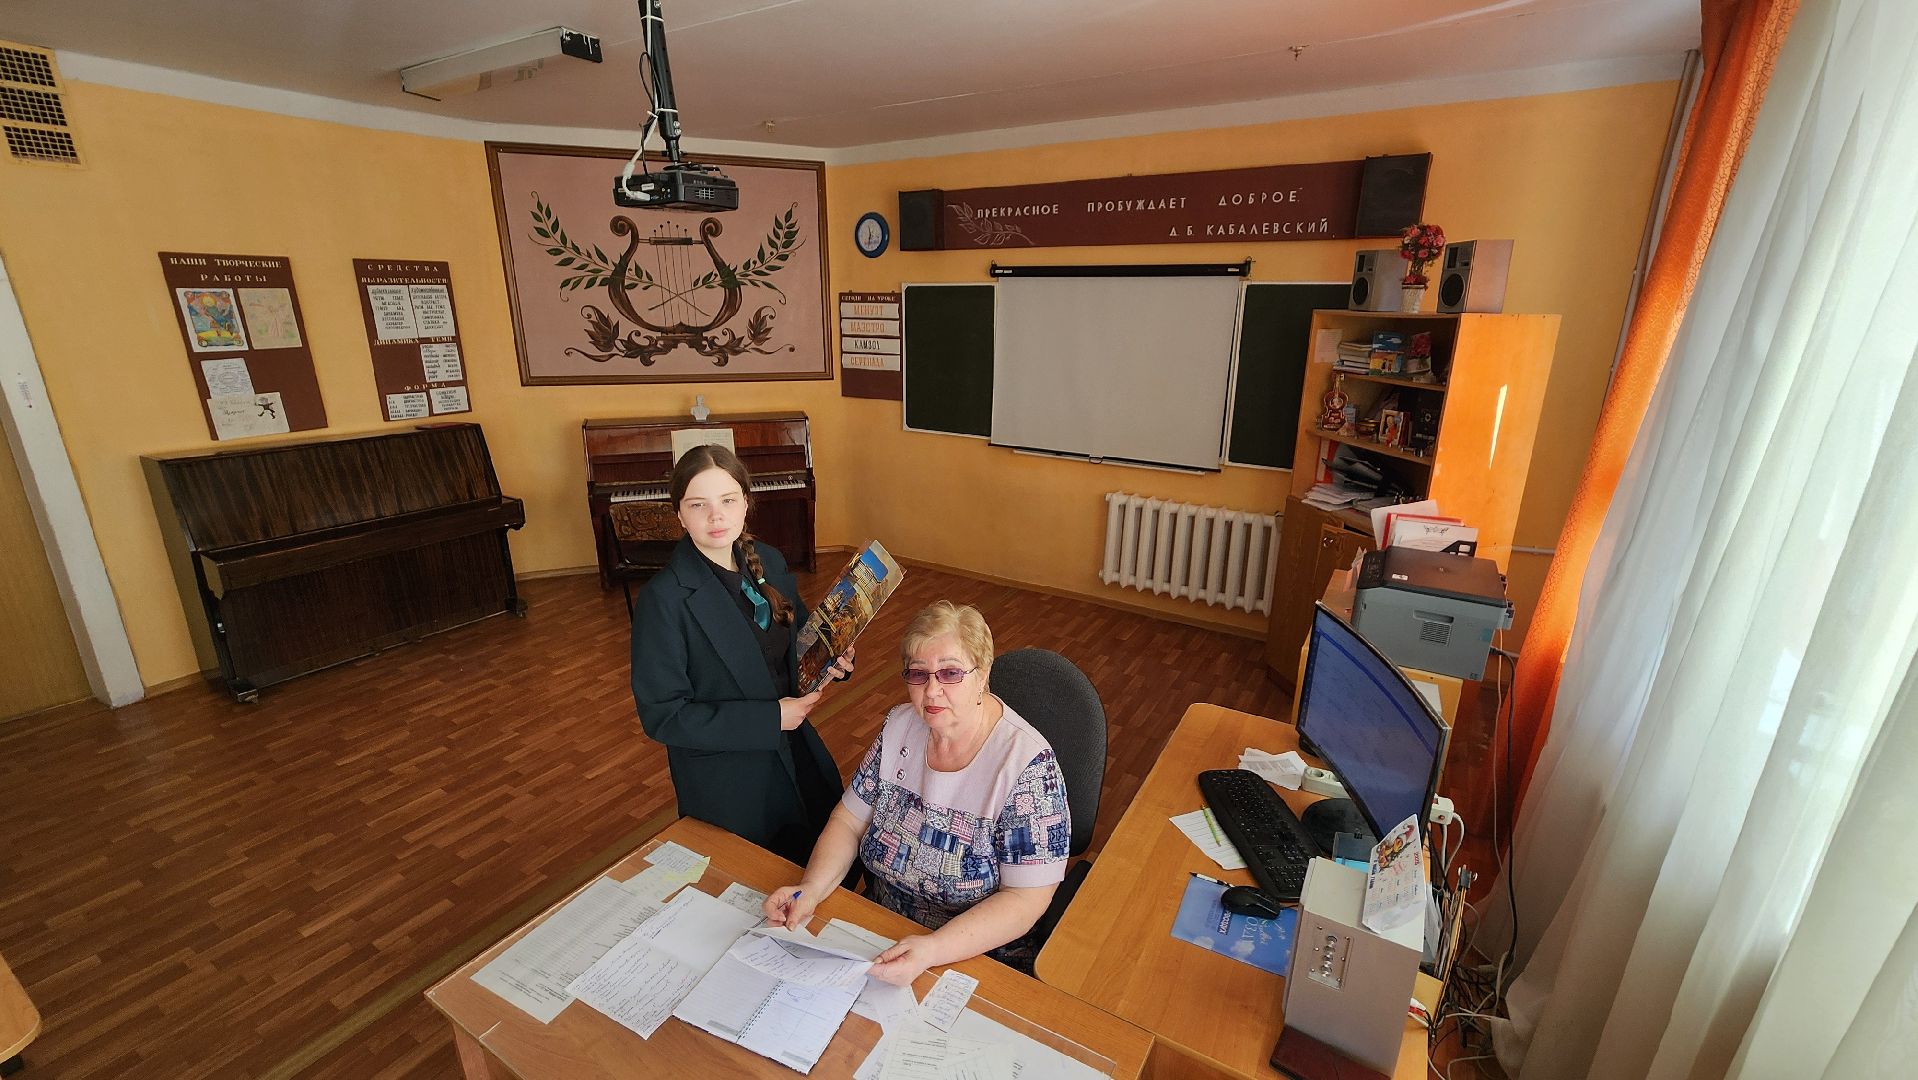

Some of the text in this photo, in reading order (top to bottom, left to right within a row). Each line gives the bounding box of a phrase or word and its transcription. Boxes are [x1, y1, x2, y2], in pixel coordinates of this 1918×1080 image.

[977, 204, 1059, 218] ПРЕКРАСНОЕ
[1087, 198, 1186, 213] ПРОБУЖДАЕТ
[1206, 218, 1328, 236] КАБАЛЕВСКИЙ
[170, 257, 282, 268] НАШИ ТВОРЧЕСКИЕ
[367, 264, 439, 272] СРЕДСТВА
[200, 273, 267, 282] РАБОТЫ
[361, 276, 449, 284] ВЫРАЗИТЕЛЬНОСТИ
[850, 321, 885, 333] МАЭСТРО
[373, 338, 420, 346] ДИНАМИКА
[404, 382, 447, 391] ФОРМА
